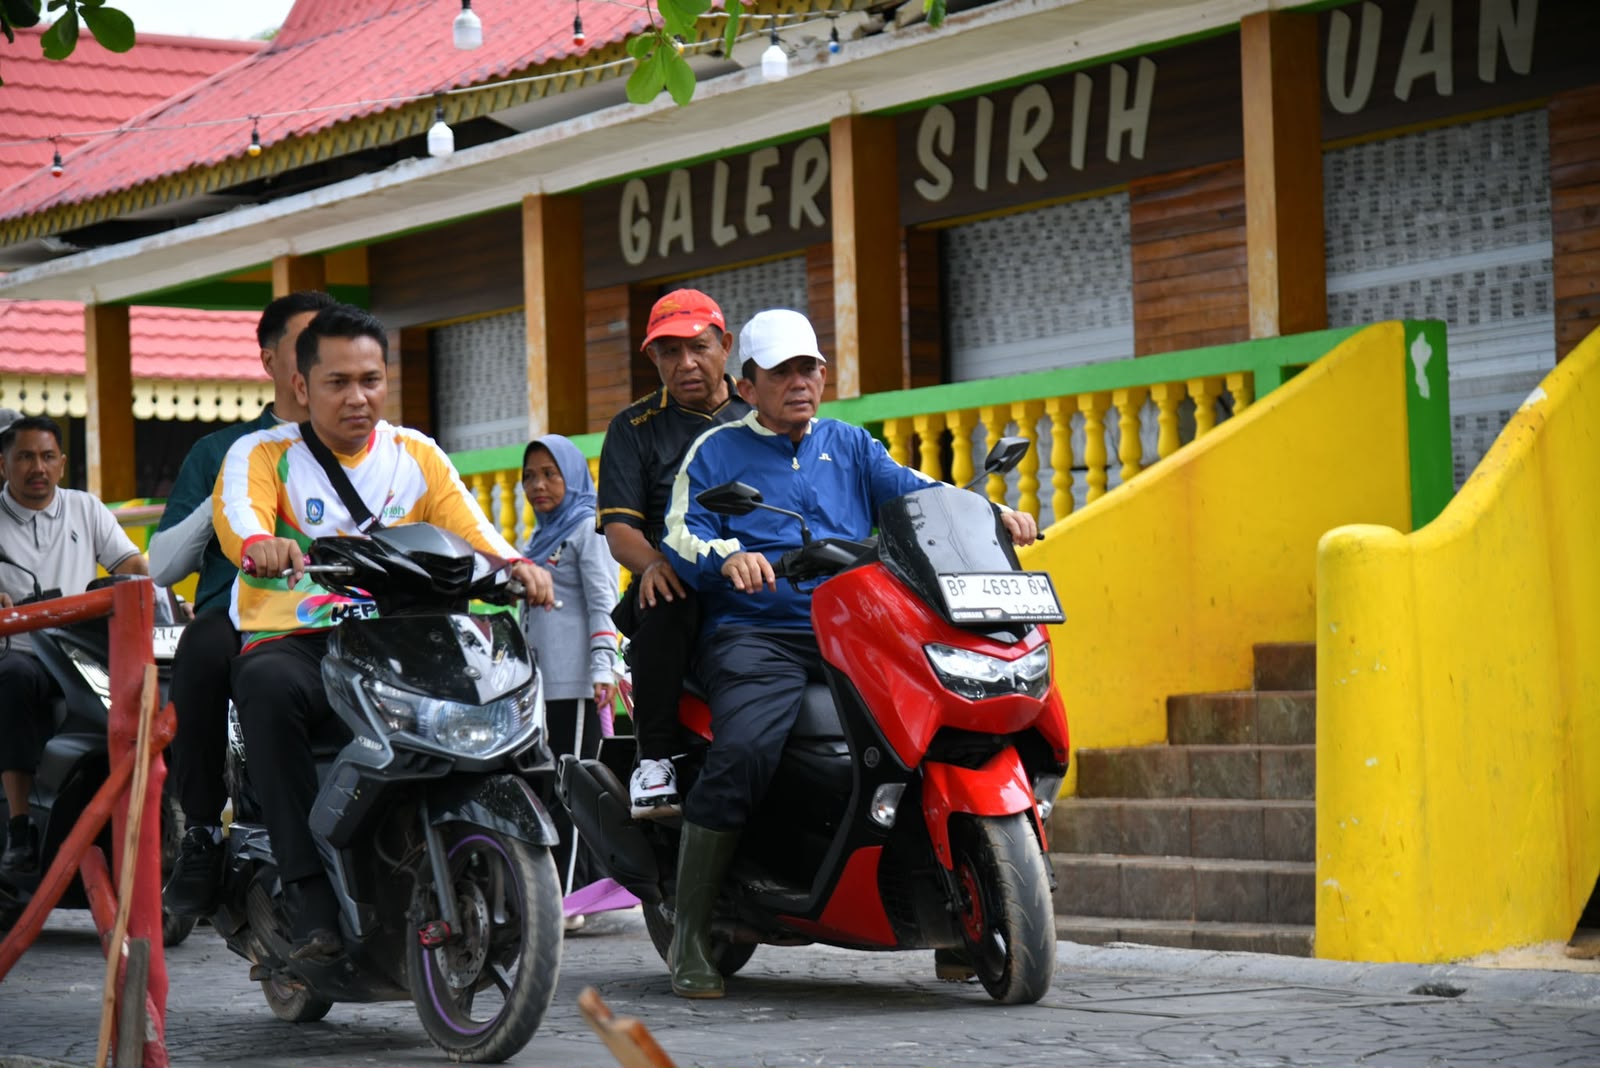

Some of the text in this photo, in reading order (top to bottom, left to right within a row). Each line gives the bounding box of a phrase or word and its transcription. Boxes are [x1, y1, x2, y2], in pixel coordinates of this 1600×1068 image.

[914, 56, 1157, 202] SIRIH
[947, 579, 967, 597] BP
[982, 579, 1022, 596] 4693
